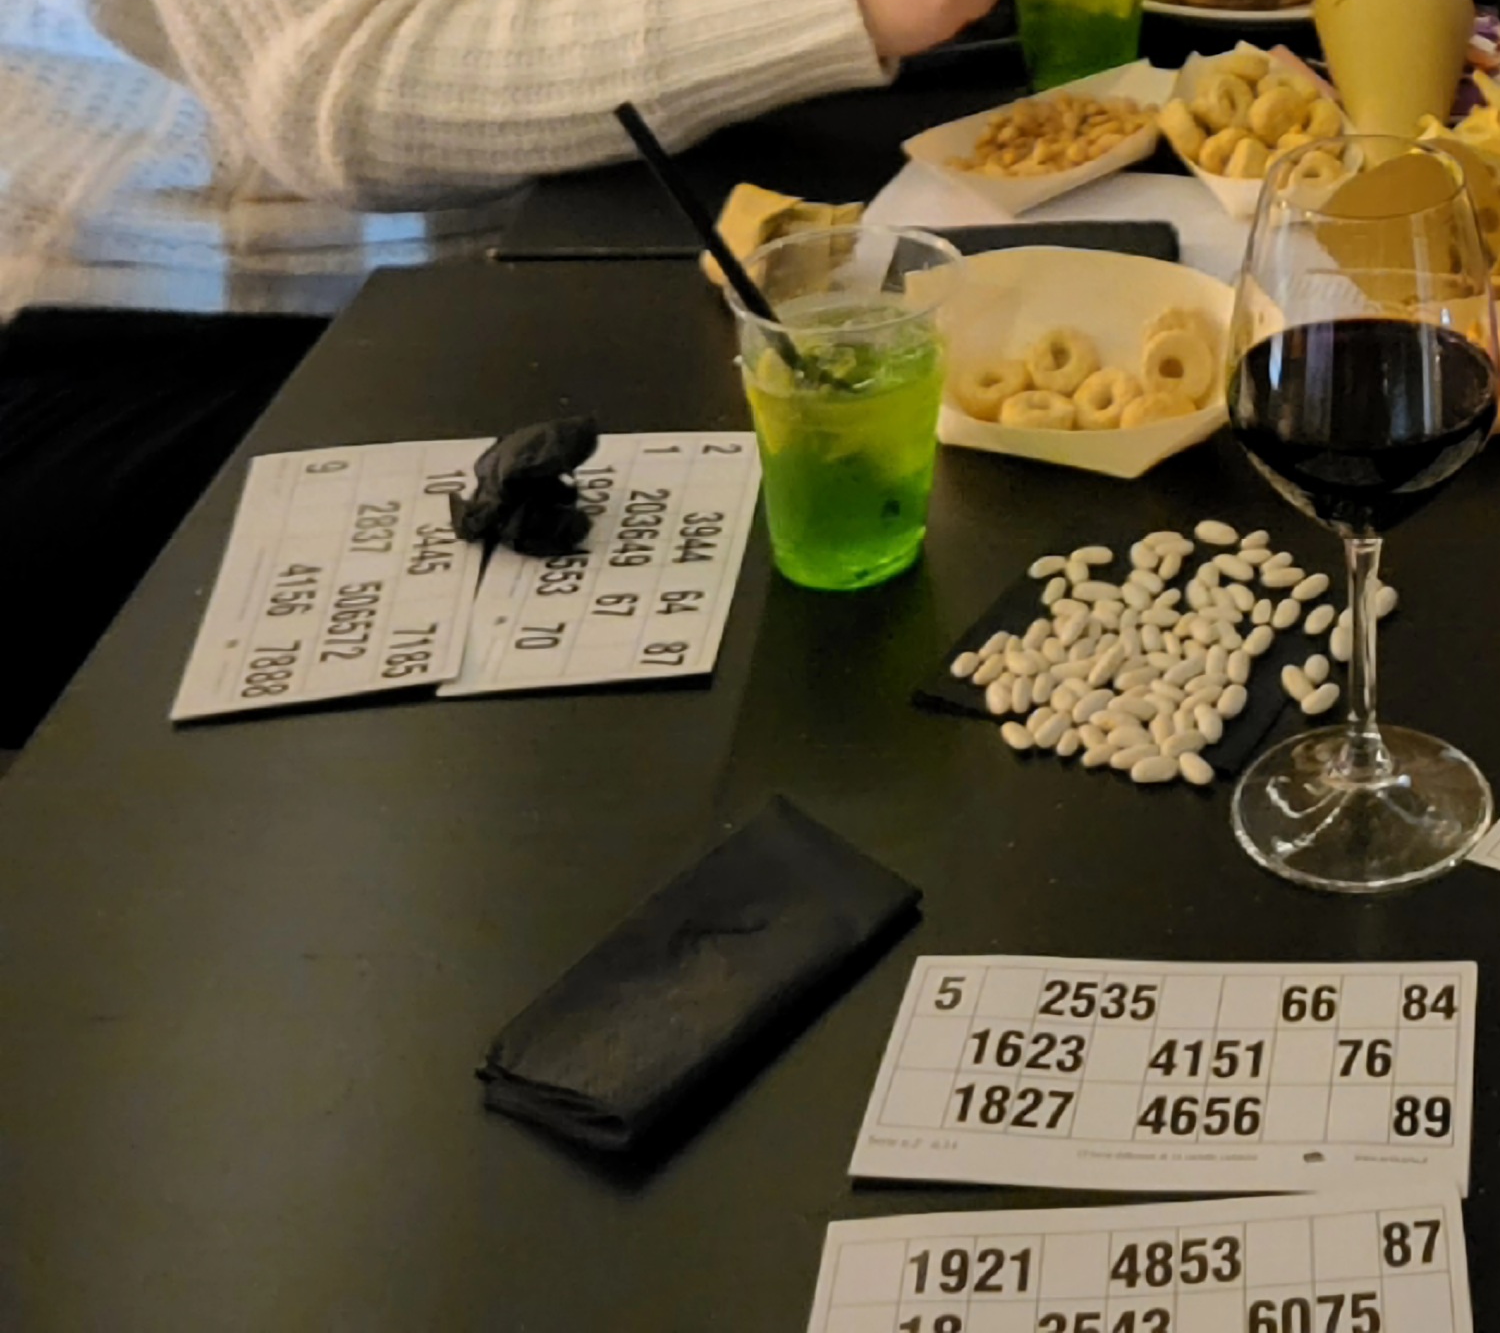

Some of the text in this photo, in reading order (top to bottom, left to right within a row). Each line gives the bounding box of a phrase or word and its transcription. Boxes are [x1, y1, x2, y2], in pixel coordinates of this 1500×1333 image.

[644, 444, 681, 454] 1
[702, 443, 742, 455] 2
[305, 460, 349, 475] 9
[423, 469, 467, 495] 10
[592, 593, 640, 617] 67
[655, 591, 705, 616] 64
[514, 622, 566, 650] 70
[640, 641, 690, 666] 87
[934, 976, 966, 1011] 5
[1281, 985, 1338, 1023] 66
[1402, 983, 1459, 1022] 84
[1337, 1038, 1393, 1078] 76
[1392, 1094, 1452, 1139] 89
[1382, 1218, 1441, 1269] 87
